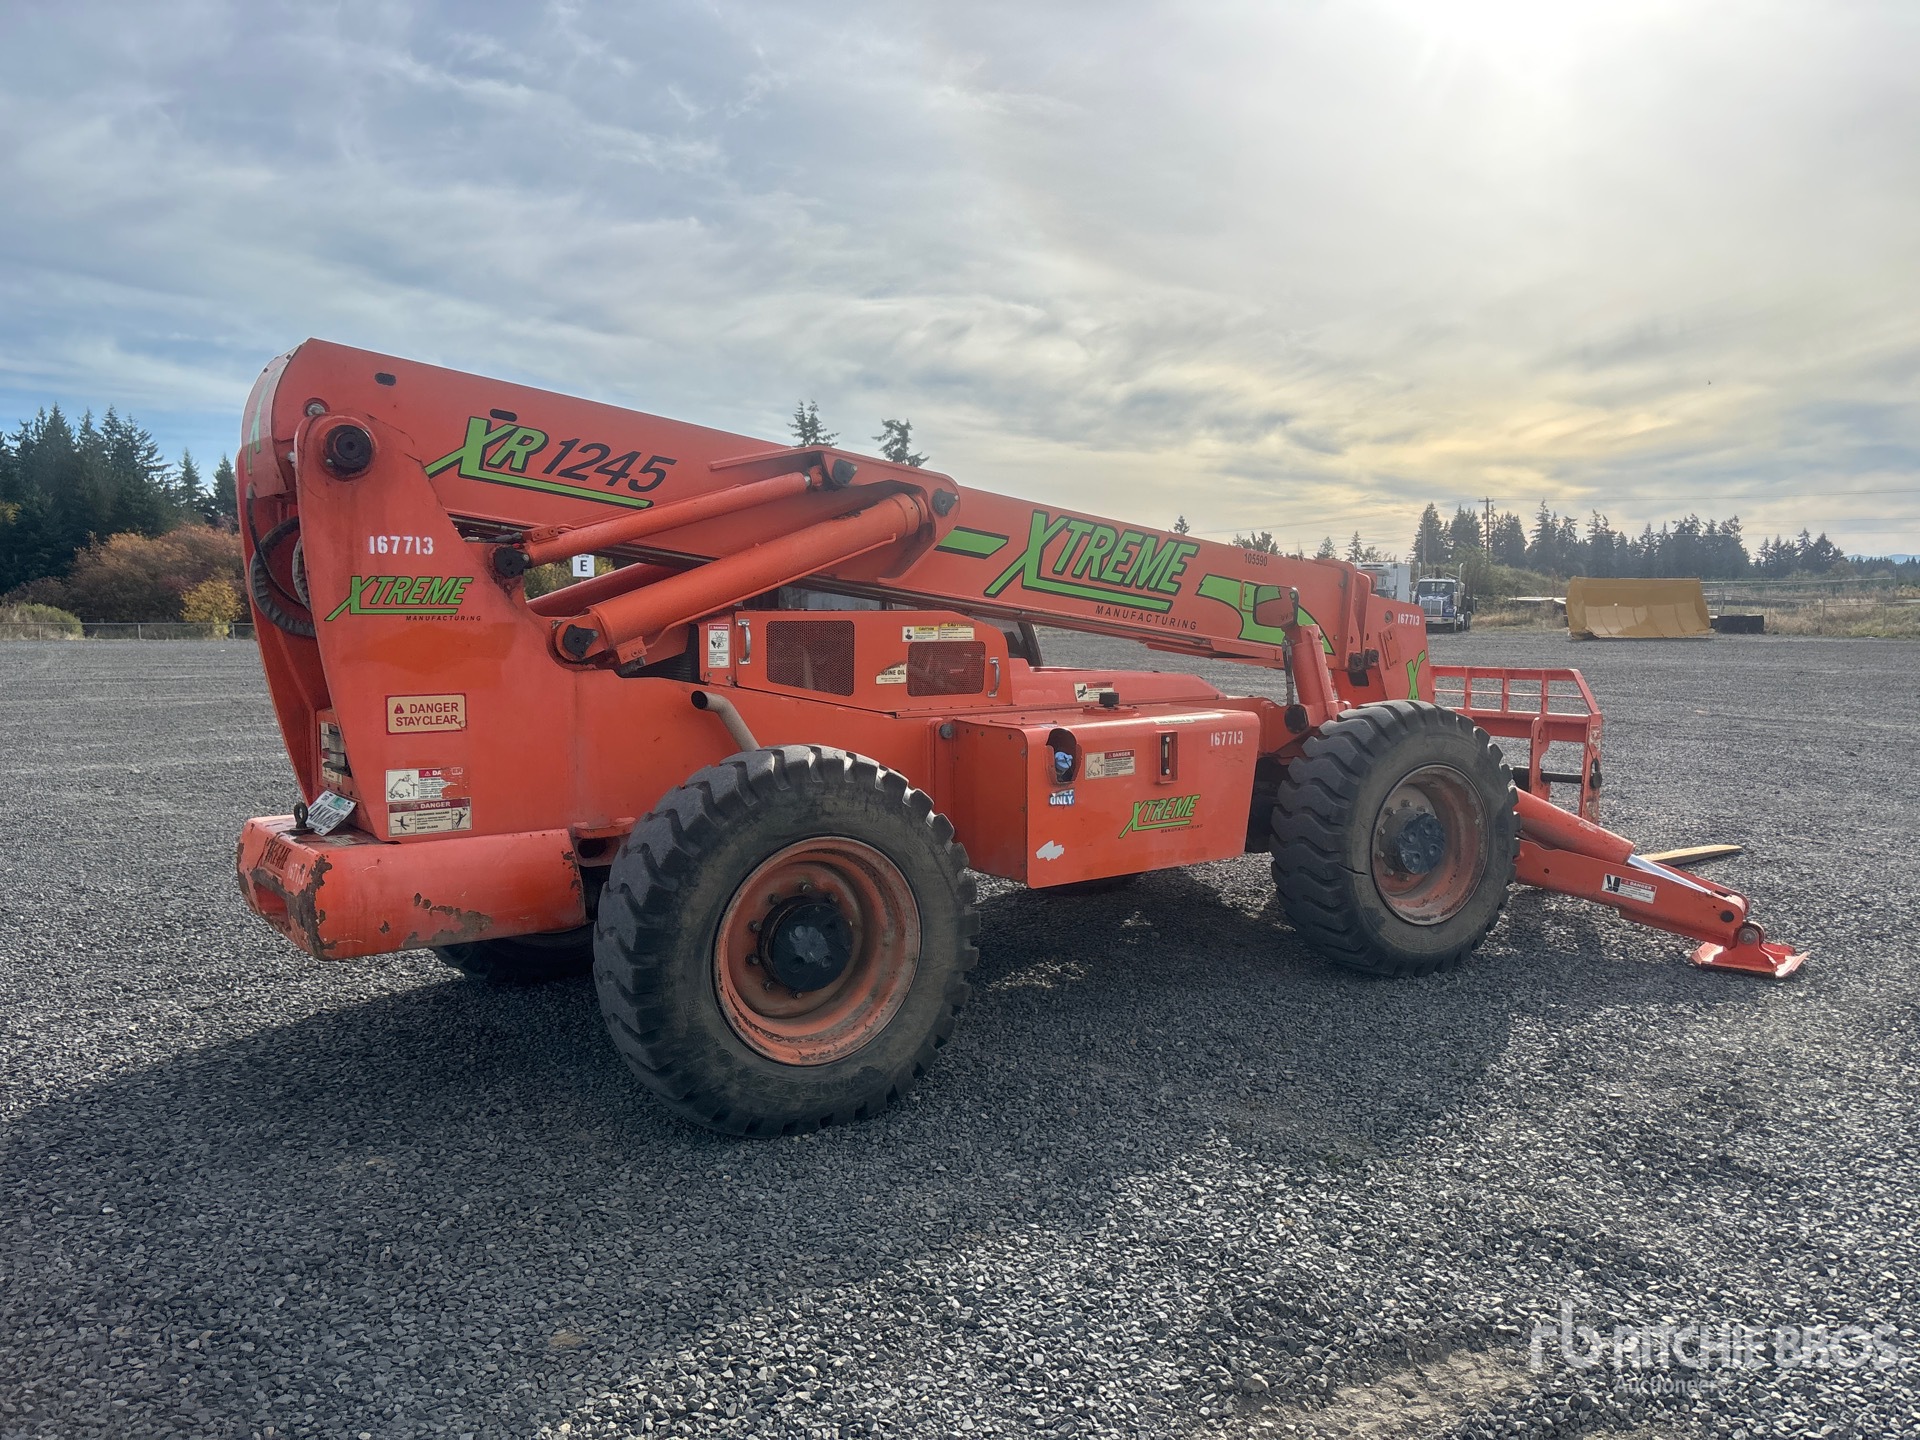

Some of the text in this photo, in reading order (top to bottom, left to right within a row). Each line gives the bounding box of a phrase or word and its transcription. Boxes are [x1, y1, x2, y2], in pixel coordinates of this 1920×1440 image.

[424, 416, 677, 492] XR 1245
[368, 535, 434, 555] 167713
[984, 509, 1200, 598] XTREME
[1244, 553, 1268, 567] 105590
[580, 560, 588, 571] E
[324, 576, 474, 622] XTREME
[1095, 604, 1198, 631] MANUFACTURING
[1397, 613, 1421, 626] 167713
[409, 702, 459, 714] DANGER
[395, 714, 460, 727] STAY CLEAR
[1210, 730, 1244, 747] 167713
[420, 801, 451, 810] DANGER
[1050, 796, 1074, 806] ONLY
[1118, 793, 1201, 840] XTREME
[1629, 881, 1653, 891] DANGER
